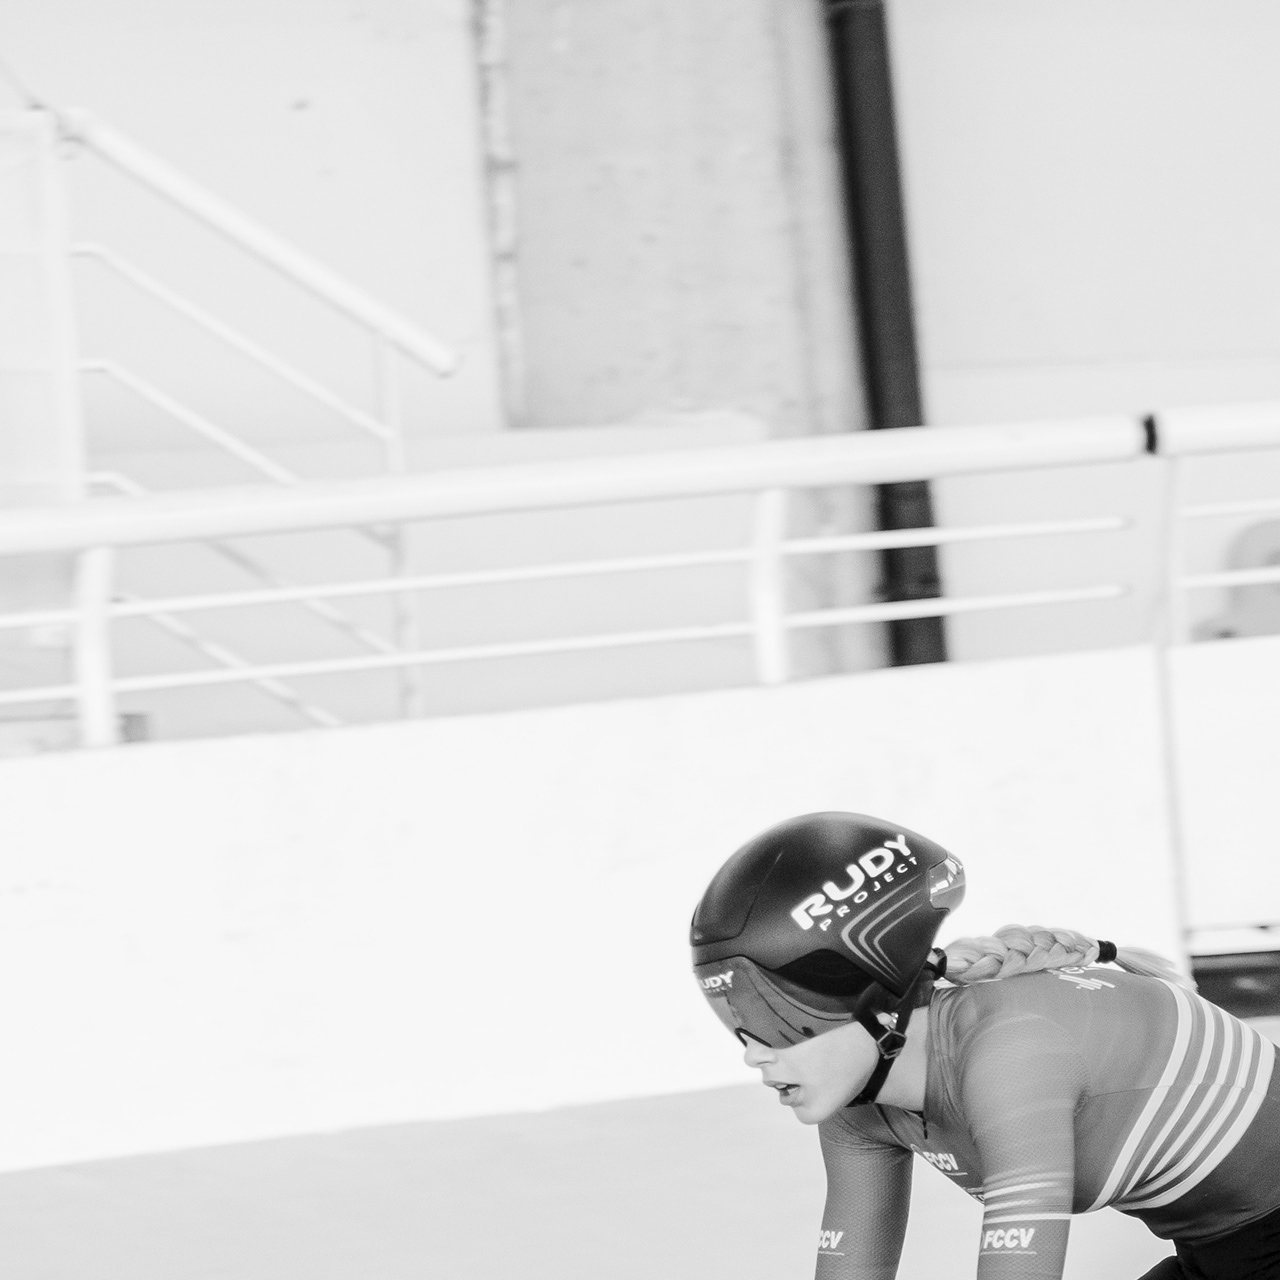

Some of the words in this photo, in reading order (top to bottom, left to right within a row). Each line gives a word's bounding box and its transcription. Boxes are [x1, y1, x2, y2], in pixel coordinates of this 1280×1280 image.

[791, 834, 911, 930] RUDY
[819, 856, 918, 932] PROJECT
[701, 970, 734, 989] UDY
[922, 1151, 959, 1171] FCCV
[983, 1228, 1035, 1249] FCCV
